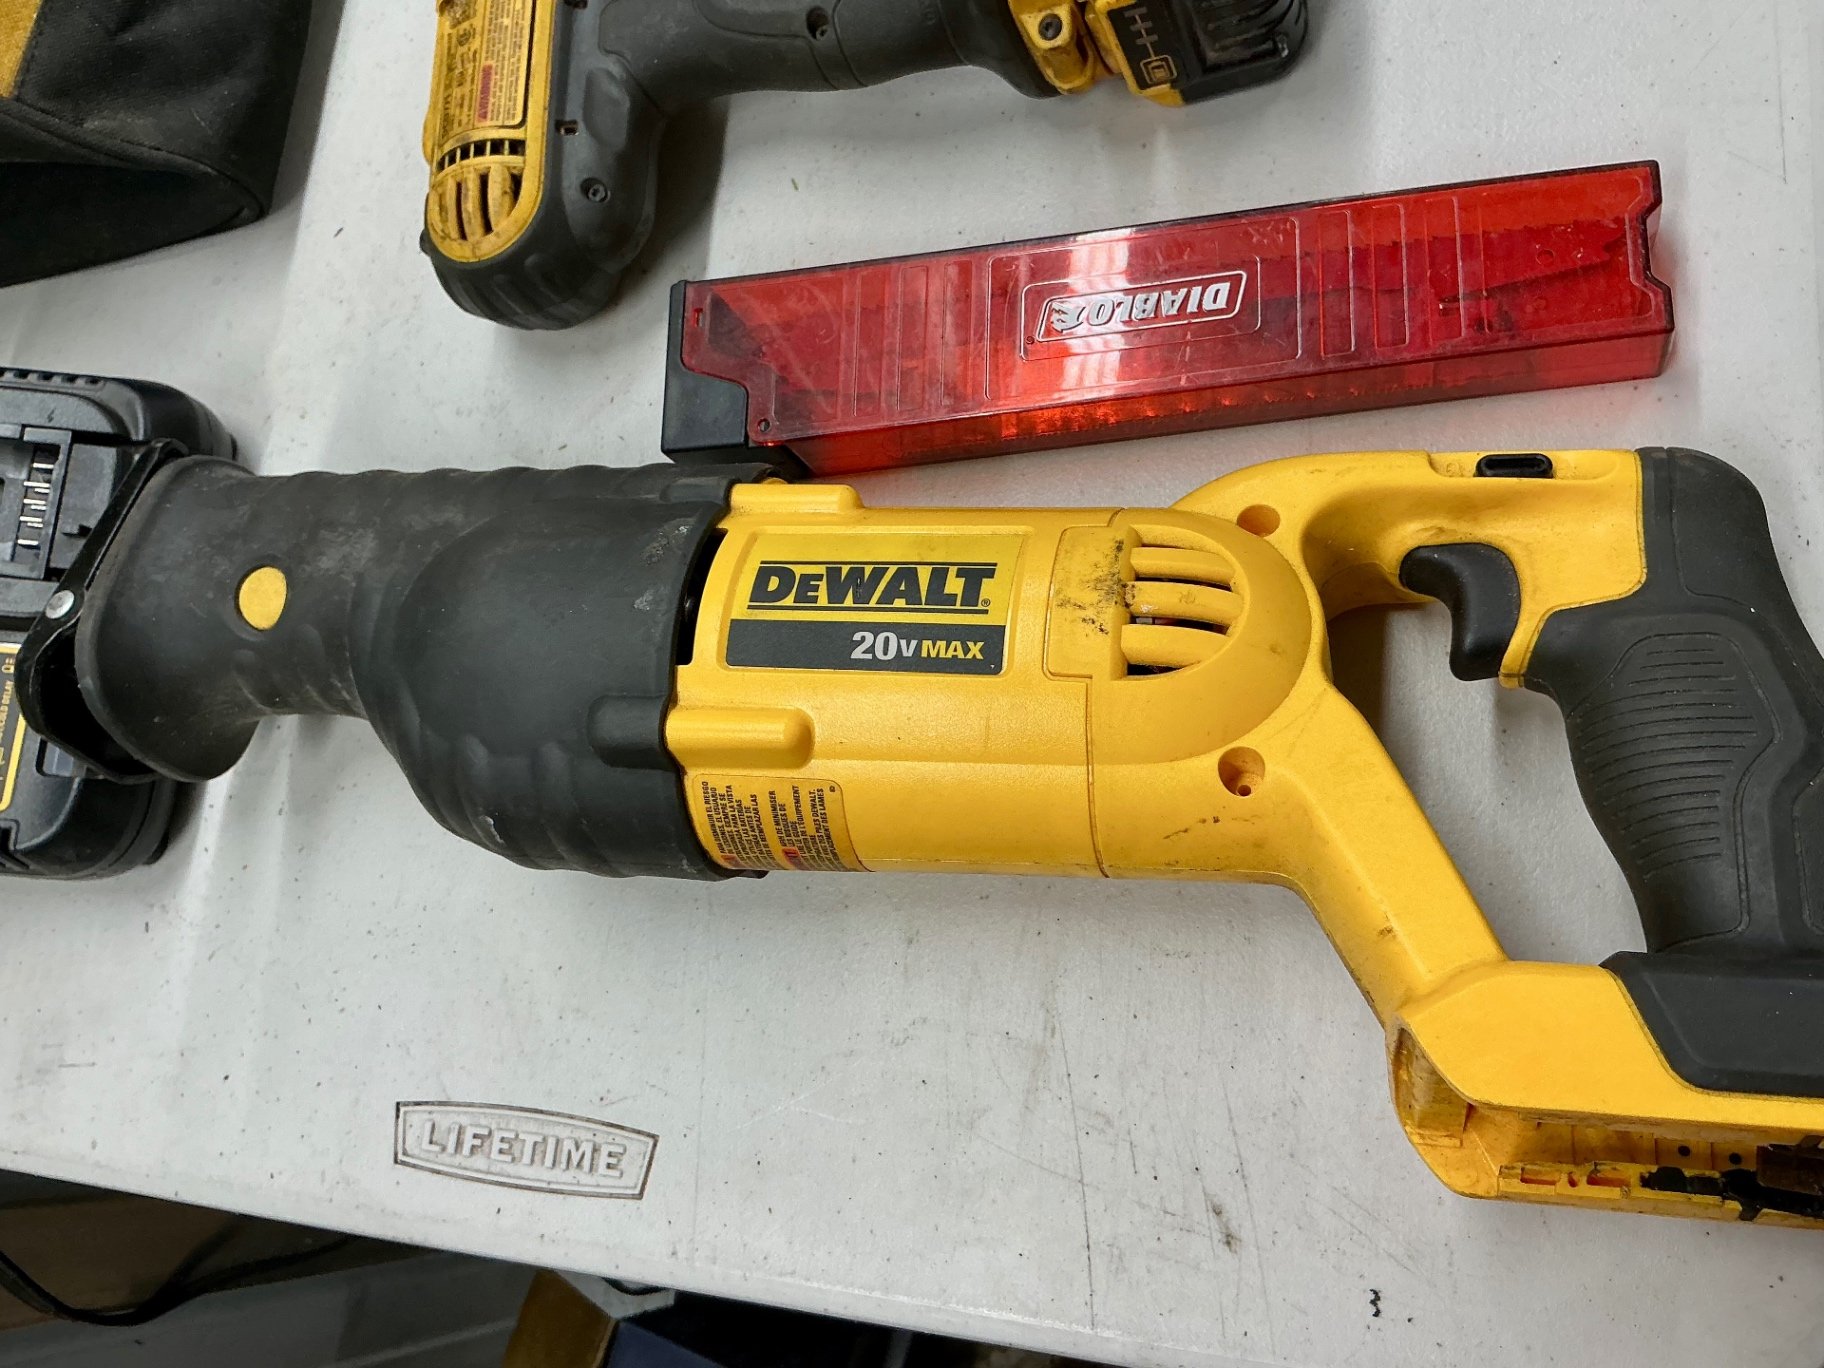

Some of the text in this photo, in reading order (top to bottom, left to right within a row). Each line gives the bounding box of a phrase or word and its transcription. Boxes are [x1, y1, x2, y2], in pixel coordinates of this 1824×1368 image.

[1088, 282, 1231, 326] DIABLO
[920, 640, 985, 660] MAX
[702, 782, 711, 805] RIESGO
[710, 787, 720, 815] USUARIO
[719, 793, 726, 801] SE
[726, 785, 734, 804] VISTA
[750, 794, 758, 806] LAS
[817, 788, 825, 811] LAMES
[769, 791, 781, 826] MINIMISER
[420, 1118, 628, 1179] LIFETIME
